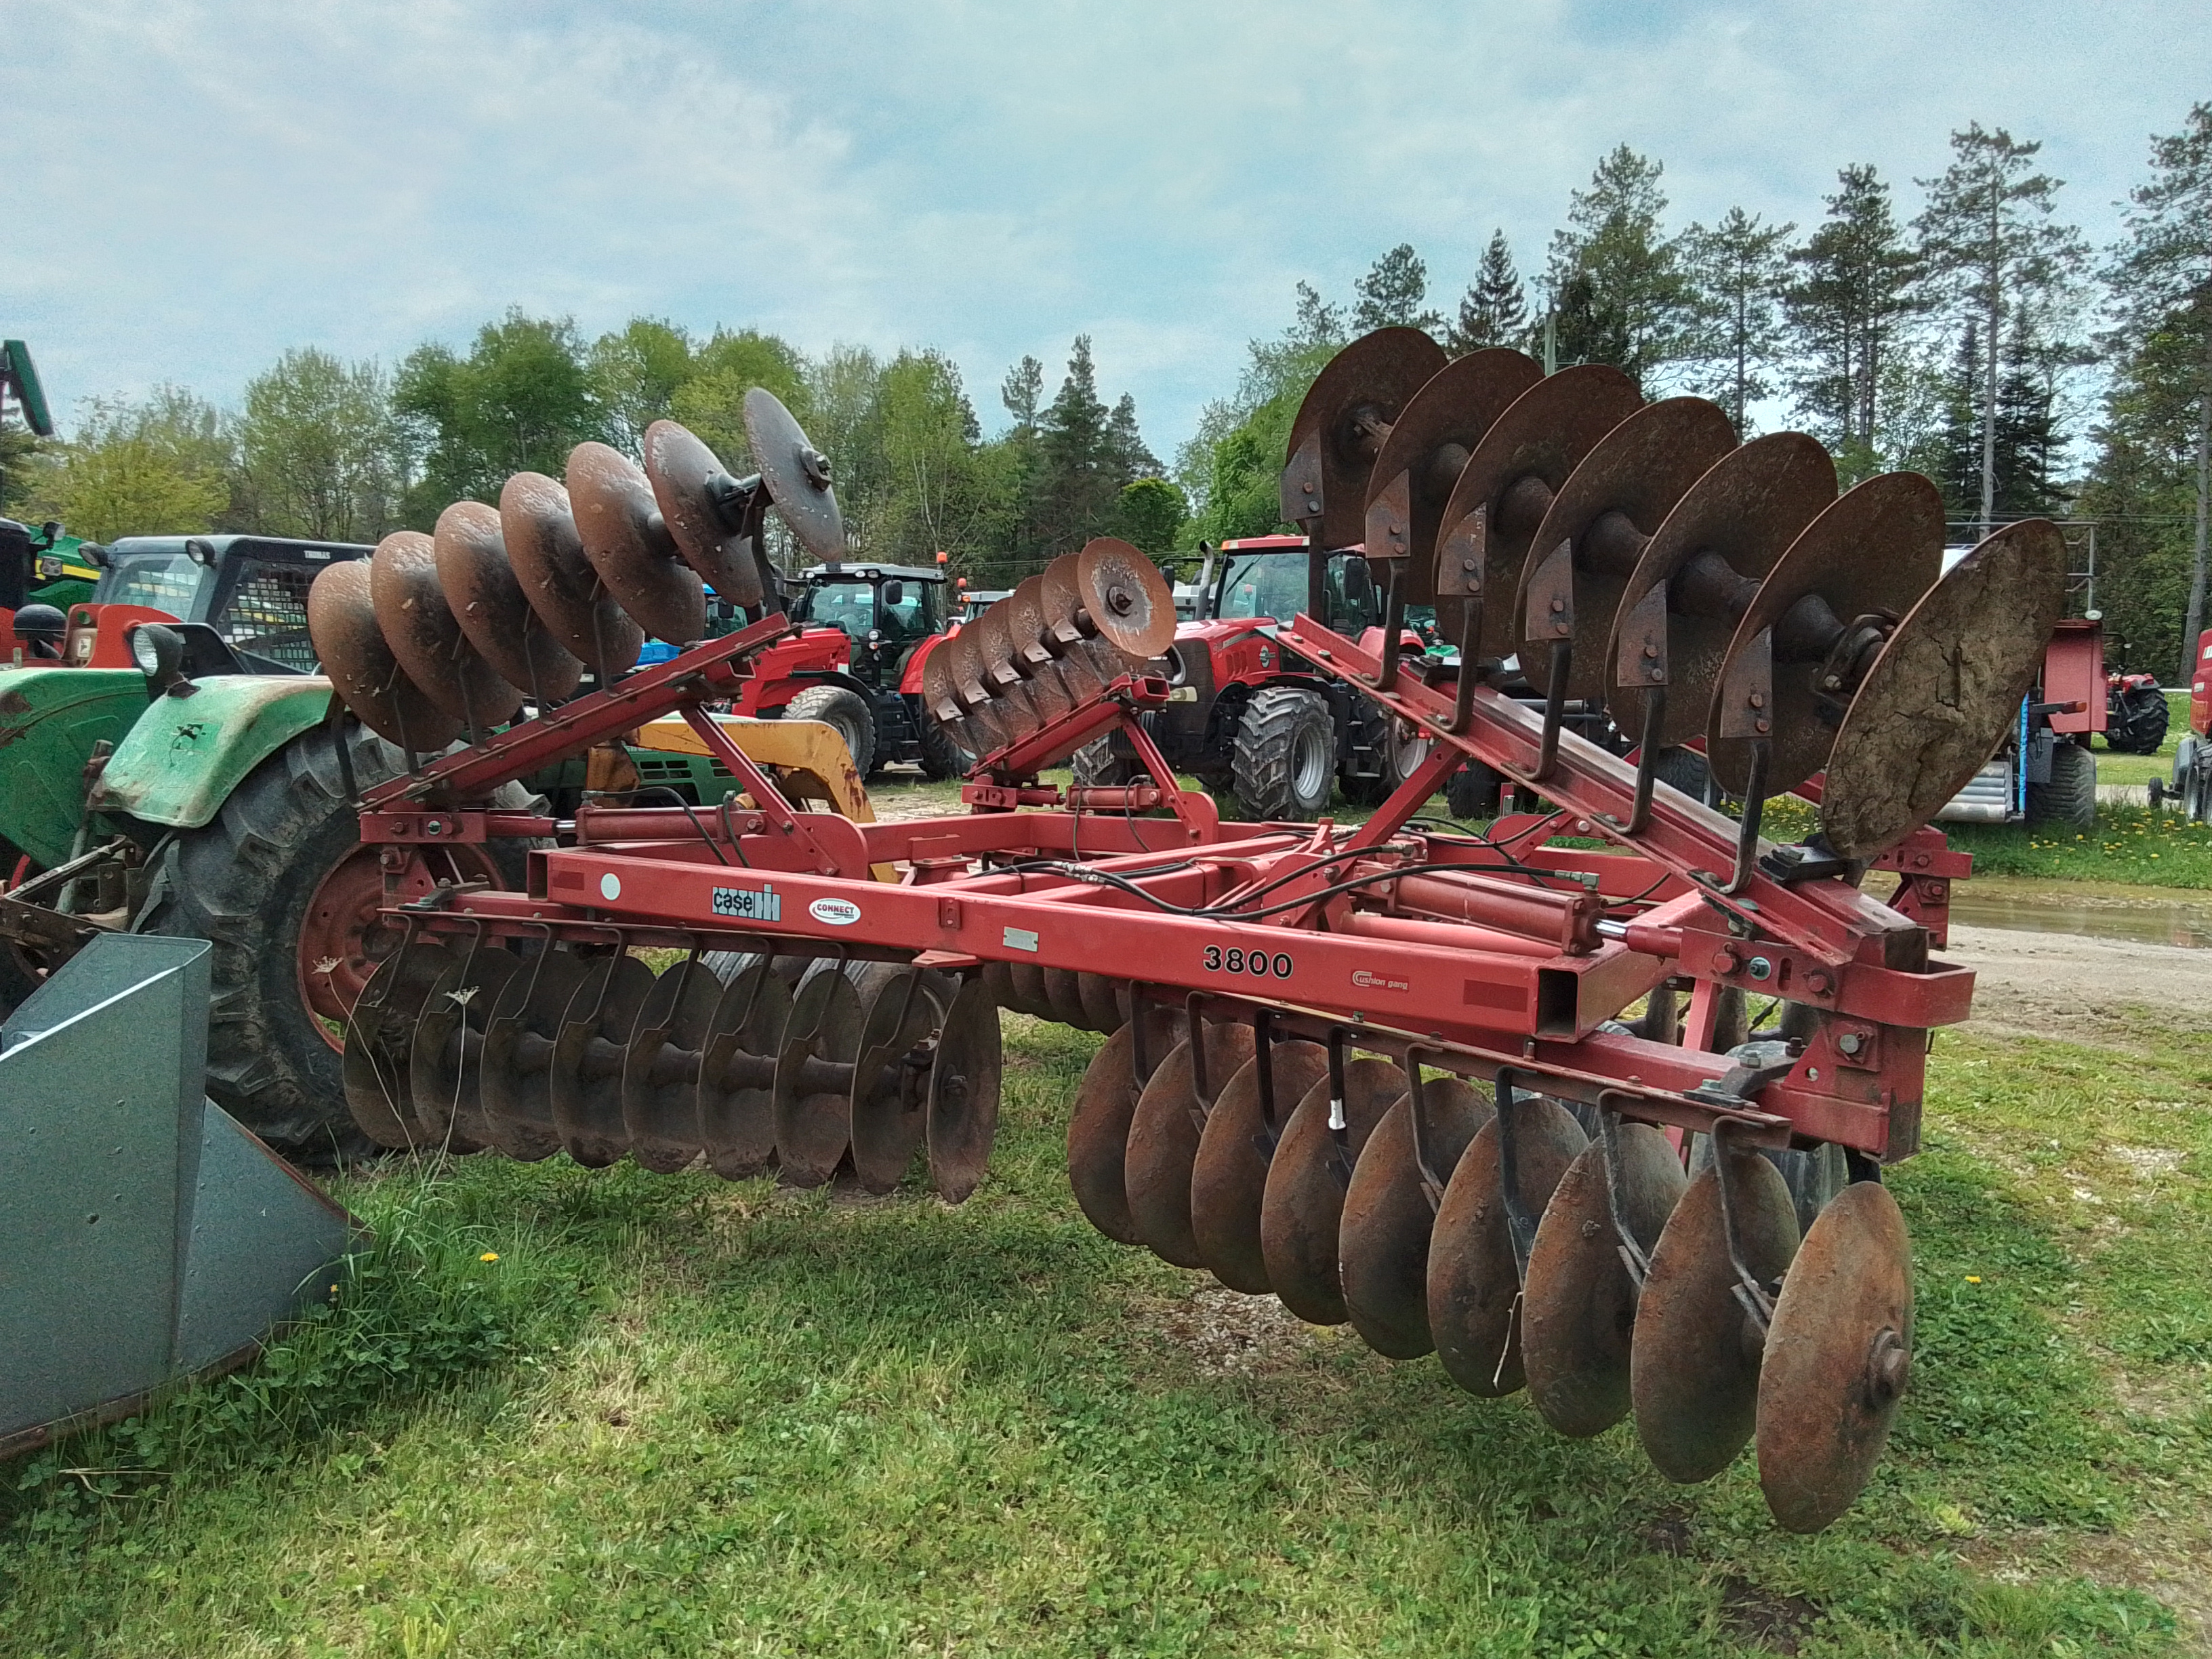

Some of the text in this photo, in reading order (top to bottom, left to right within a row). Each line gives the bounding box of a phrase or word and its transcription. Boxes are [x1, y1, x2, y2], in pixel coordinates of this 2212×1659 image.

[304, 550, 331, 559] TAS
[817, 903, 855, 914] CONNECT
[1203, 944, 1294, 980] 3800
[1352, 970, 1408, 990] Cushion gang
